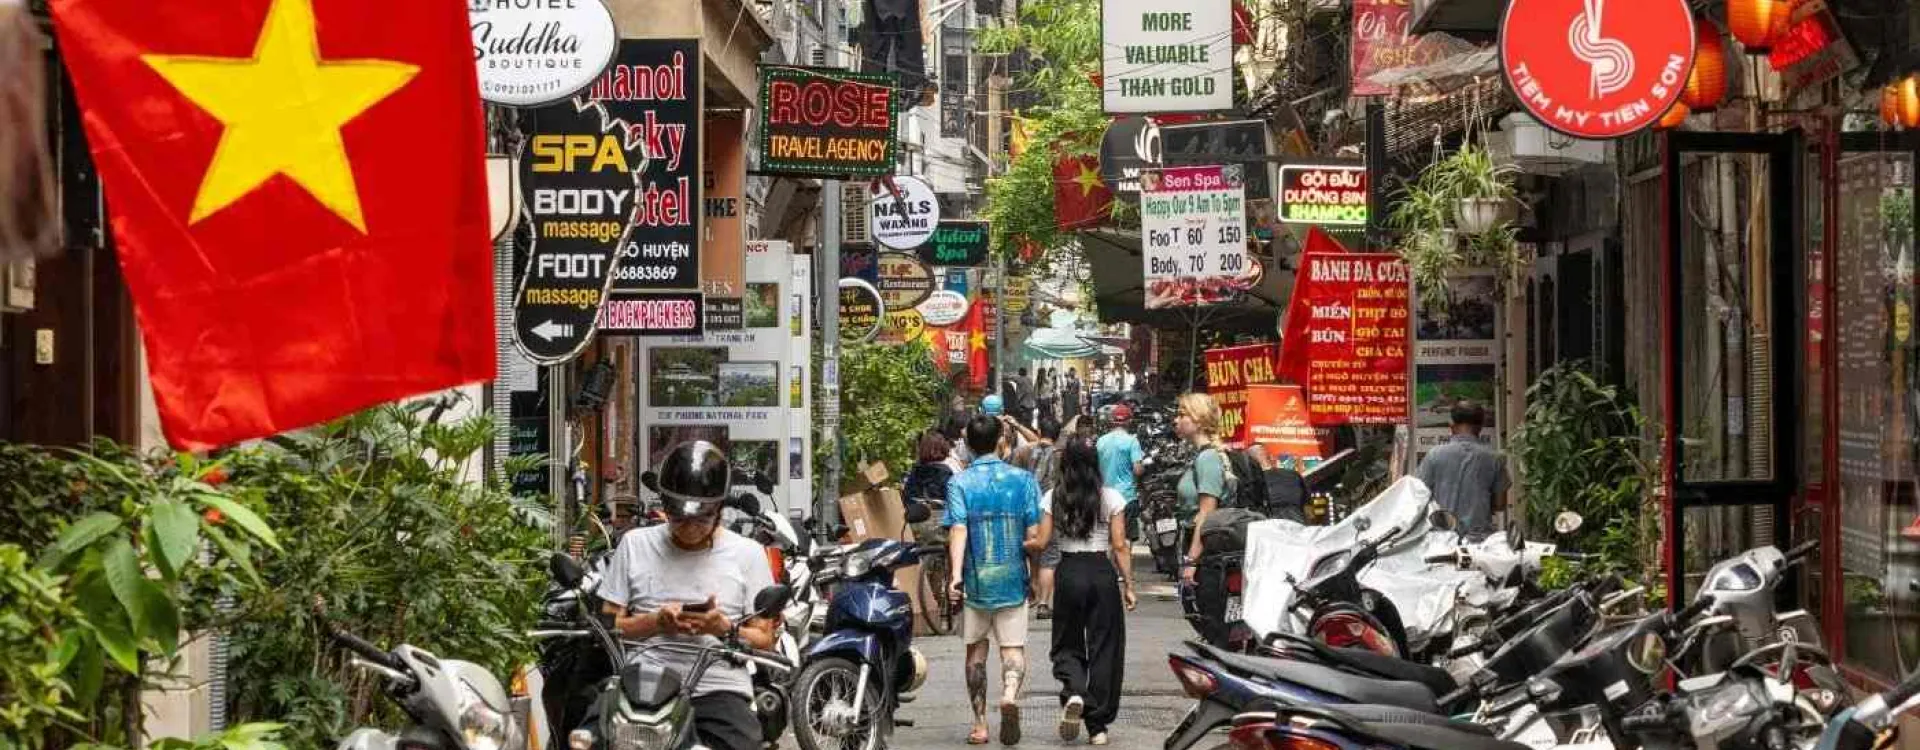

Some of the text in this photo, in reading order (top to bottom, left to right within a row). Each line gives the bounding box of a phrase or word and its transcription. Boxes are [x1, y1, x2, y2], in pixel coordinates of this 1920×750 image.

[1142, 12, 1192, 32] MORE
[488, 59, 582, 69] BOUTIQUE
[1125, 44, 1209, 64] VALUABLE
[1119, 77, 1215, 97] THAN GOLD
[1513, 53, 1686, 127] TIEM MY TIEN SON
[769, 80, 890, 128] ROSE
[531, 134, 629, 173] SPA
[770, 135, 888, 161] TRAVEL AGENCY
[1165, 173, 1221, 188] Sen Spa
[534, 189, 629, 215] BODY
[1189, 195, 1194, 212] 9
[543, 221, 621, 243] massage
[1218, 226, 1241, 244] 150
[643, 242, 690, 260] HUYỆN
[936, 244, 968, 261] Spa
[538, 253, 606, 279] FOOT
[1220, 253, 1242, 271] 200
[527, 287, 600, 309] massage
[608, 300, 697, 329] BACKPACKERS
[1311, 327, 1345, 342] BÚN
[1382, 327, 1405, 337] TAI
[1207, 353, 1240, 387] BÚN
